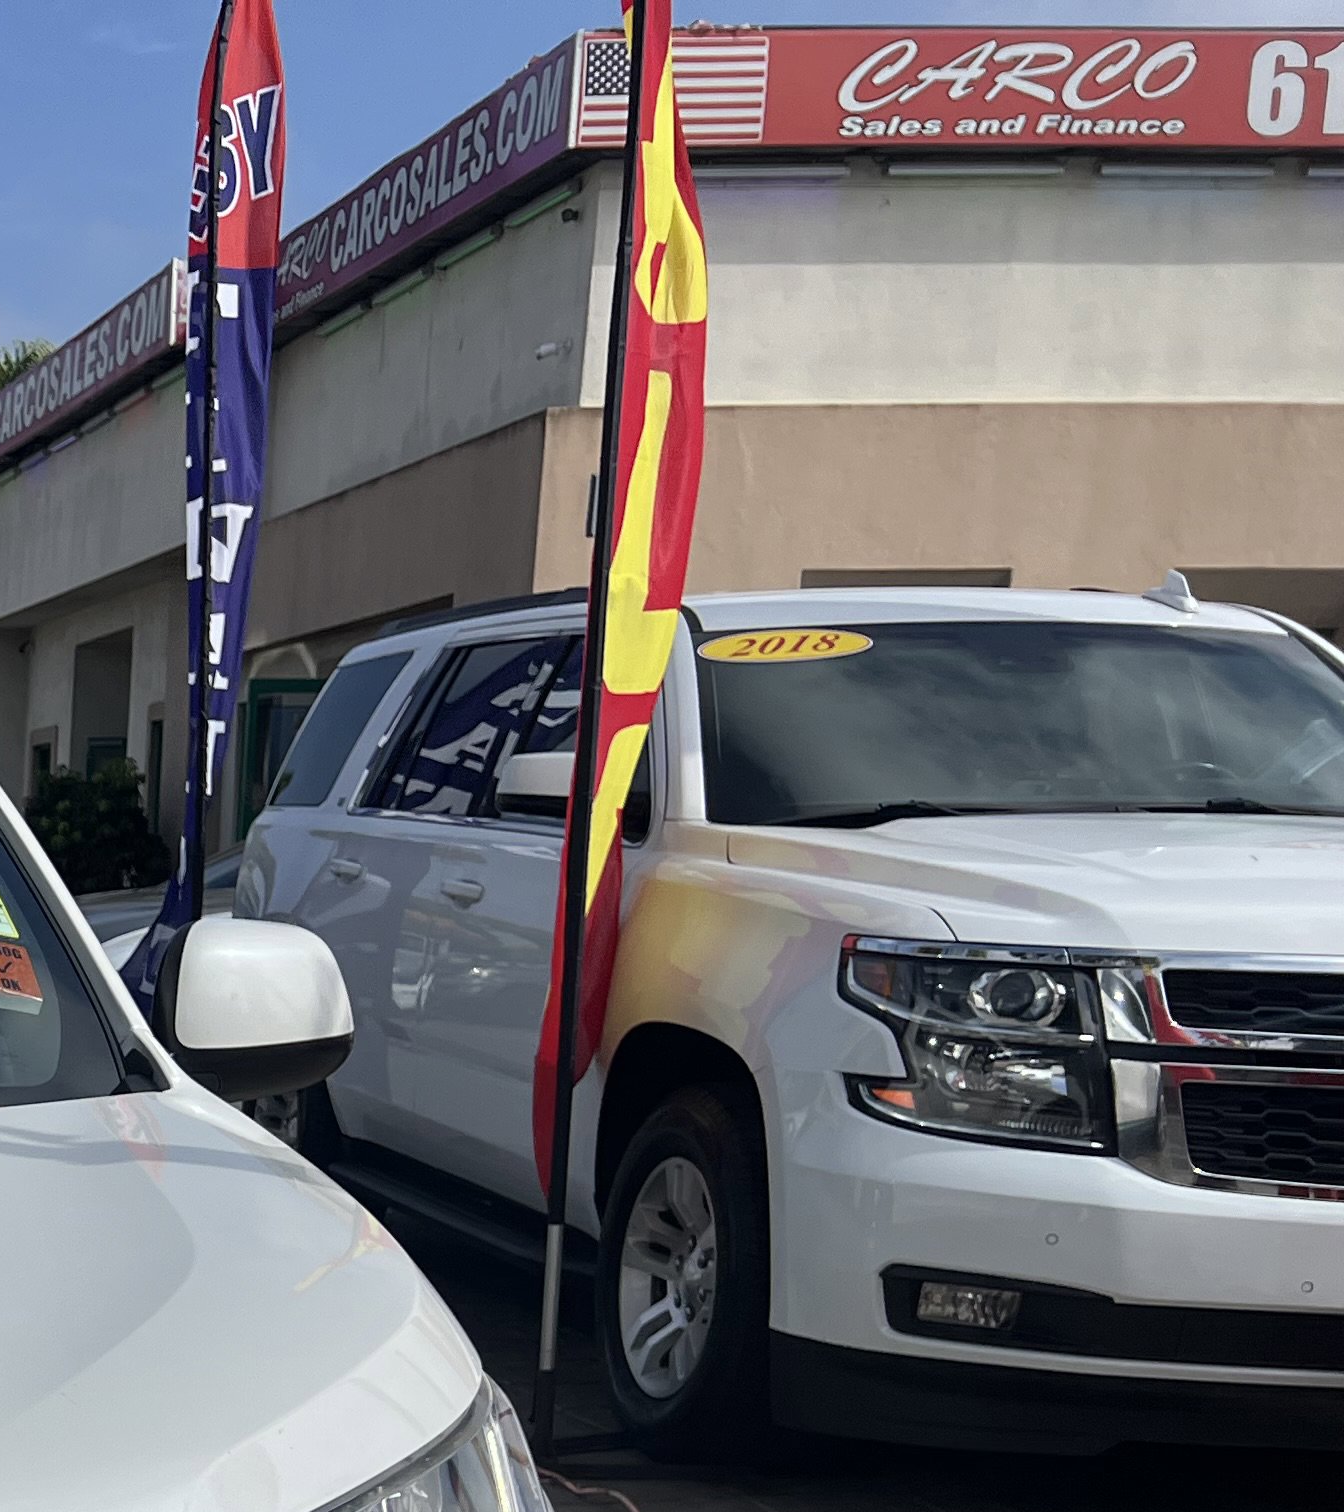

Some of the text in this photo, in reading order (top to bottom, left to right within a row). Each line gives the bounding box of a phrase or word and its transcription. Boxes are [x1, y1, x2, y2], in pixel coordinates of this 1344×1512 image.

[838, 38, 1196, 112] CARCO
[839, 114, 1186, 137] Sales and Finance
[330, 55, 565, 273] CARCOSALES.COM
[276, 217, 329, 287] ARCO
[729, 633, 841, 657] 2018
[1, 977, 22, 992] OK
